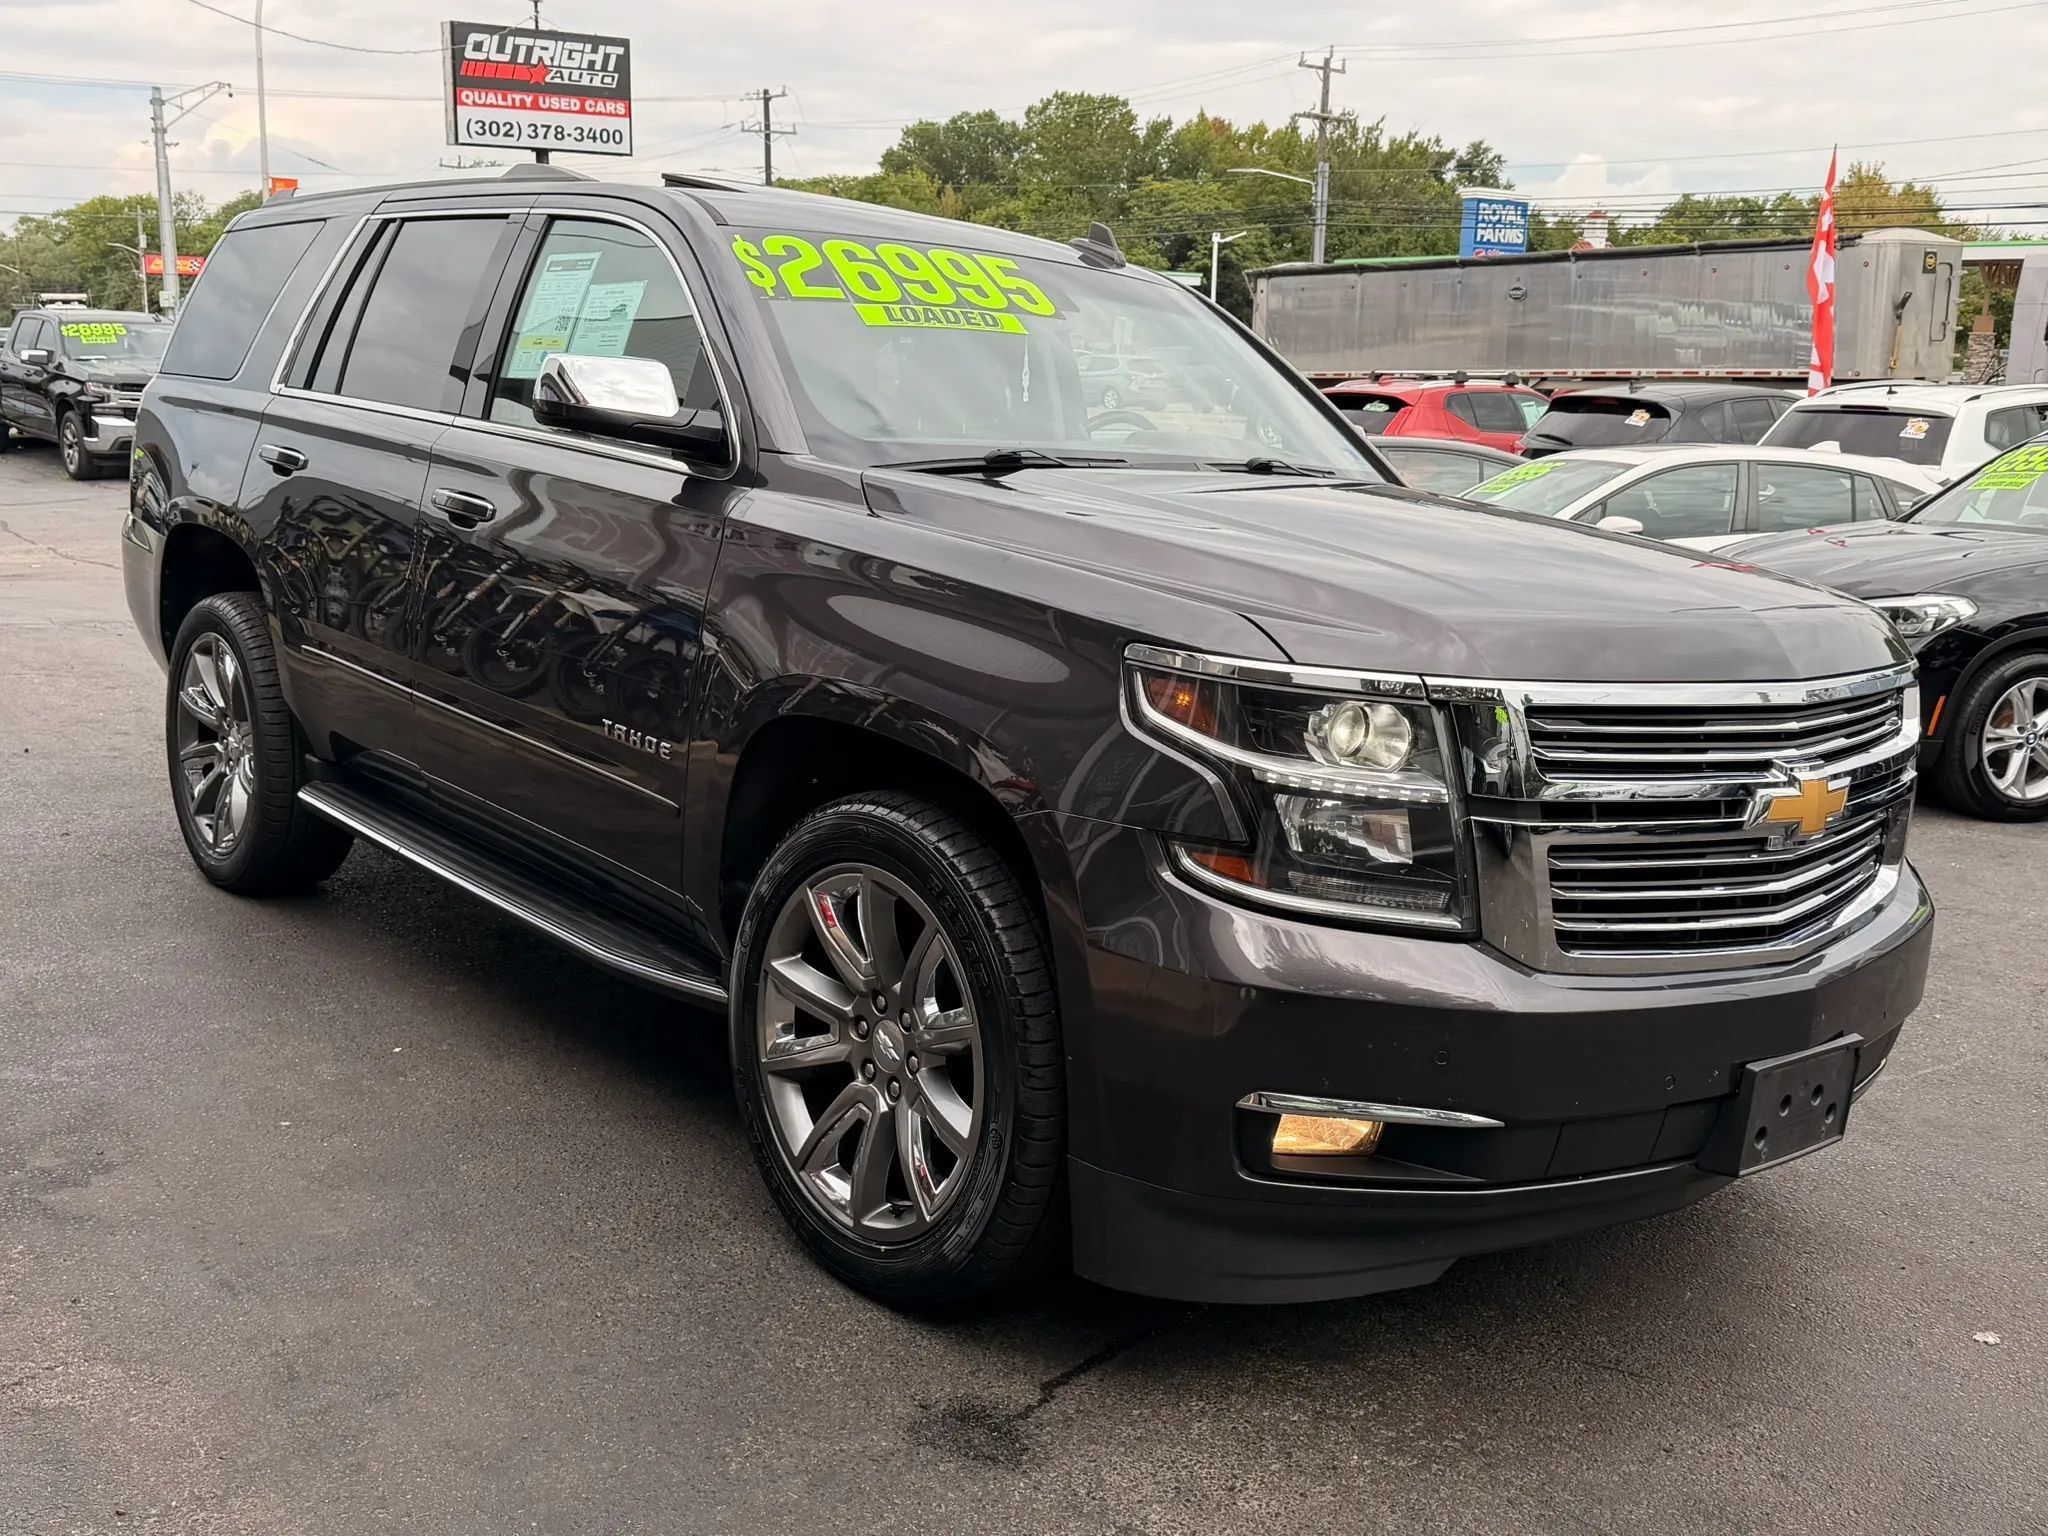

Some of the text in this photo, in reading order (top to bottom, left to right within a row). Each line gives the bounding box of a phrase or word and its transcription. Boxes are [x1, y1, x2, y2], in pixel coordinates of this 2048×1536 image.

[464, 32, 625, 72] OUTRIGHT
[550, 69, 617, 87] AUTO
[461, 90, 626, 115] QUALITY USED CARS
[466, 118, 624, 145] (302) 378-3400
[1478, 203, 1525, 225] ROYAL
[1476, 222, 1524, 244] FARMS
[732, 234, 1057, 317] $26995
[884, 304, 1004, 330] LOADED
[602, 718, 672, 760] TAHOE
